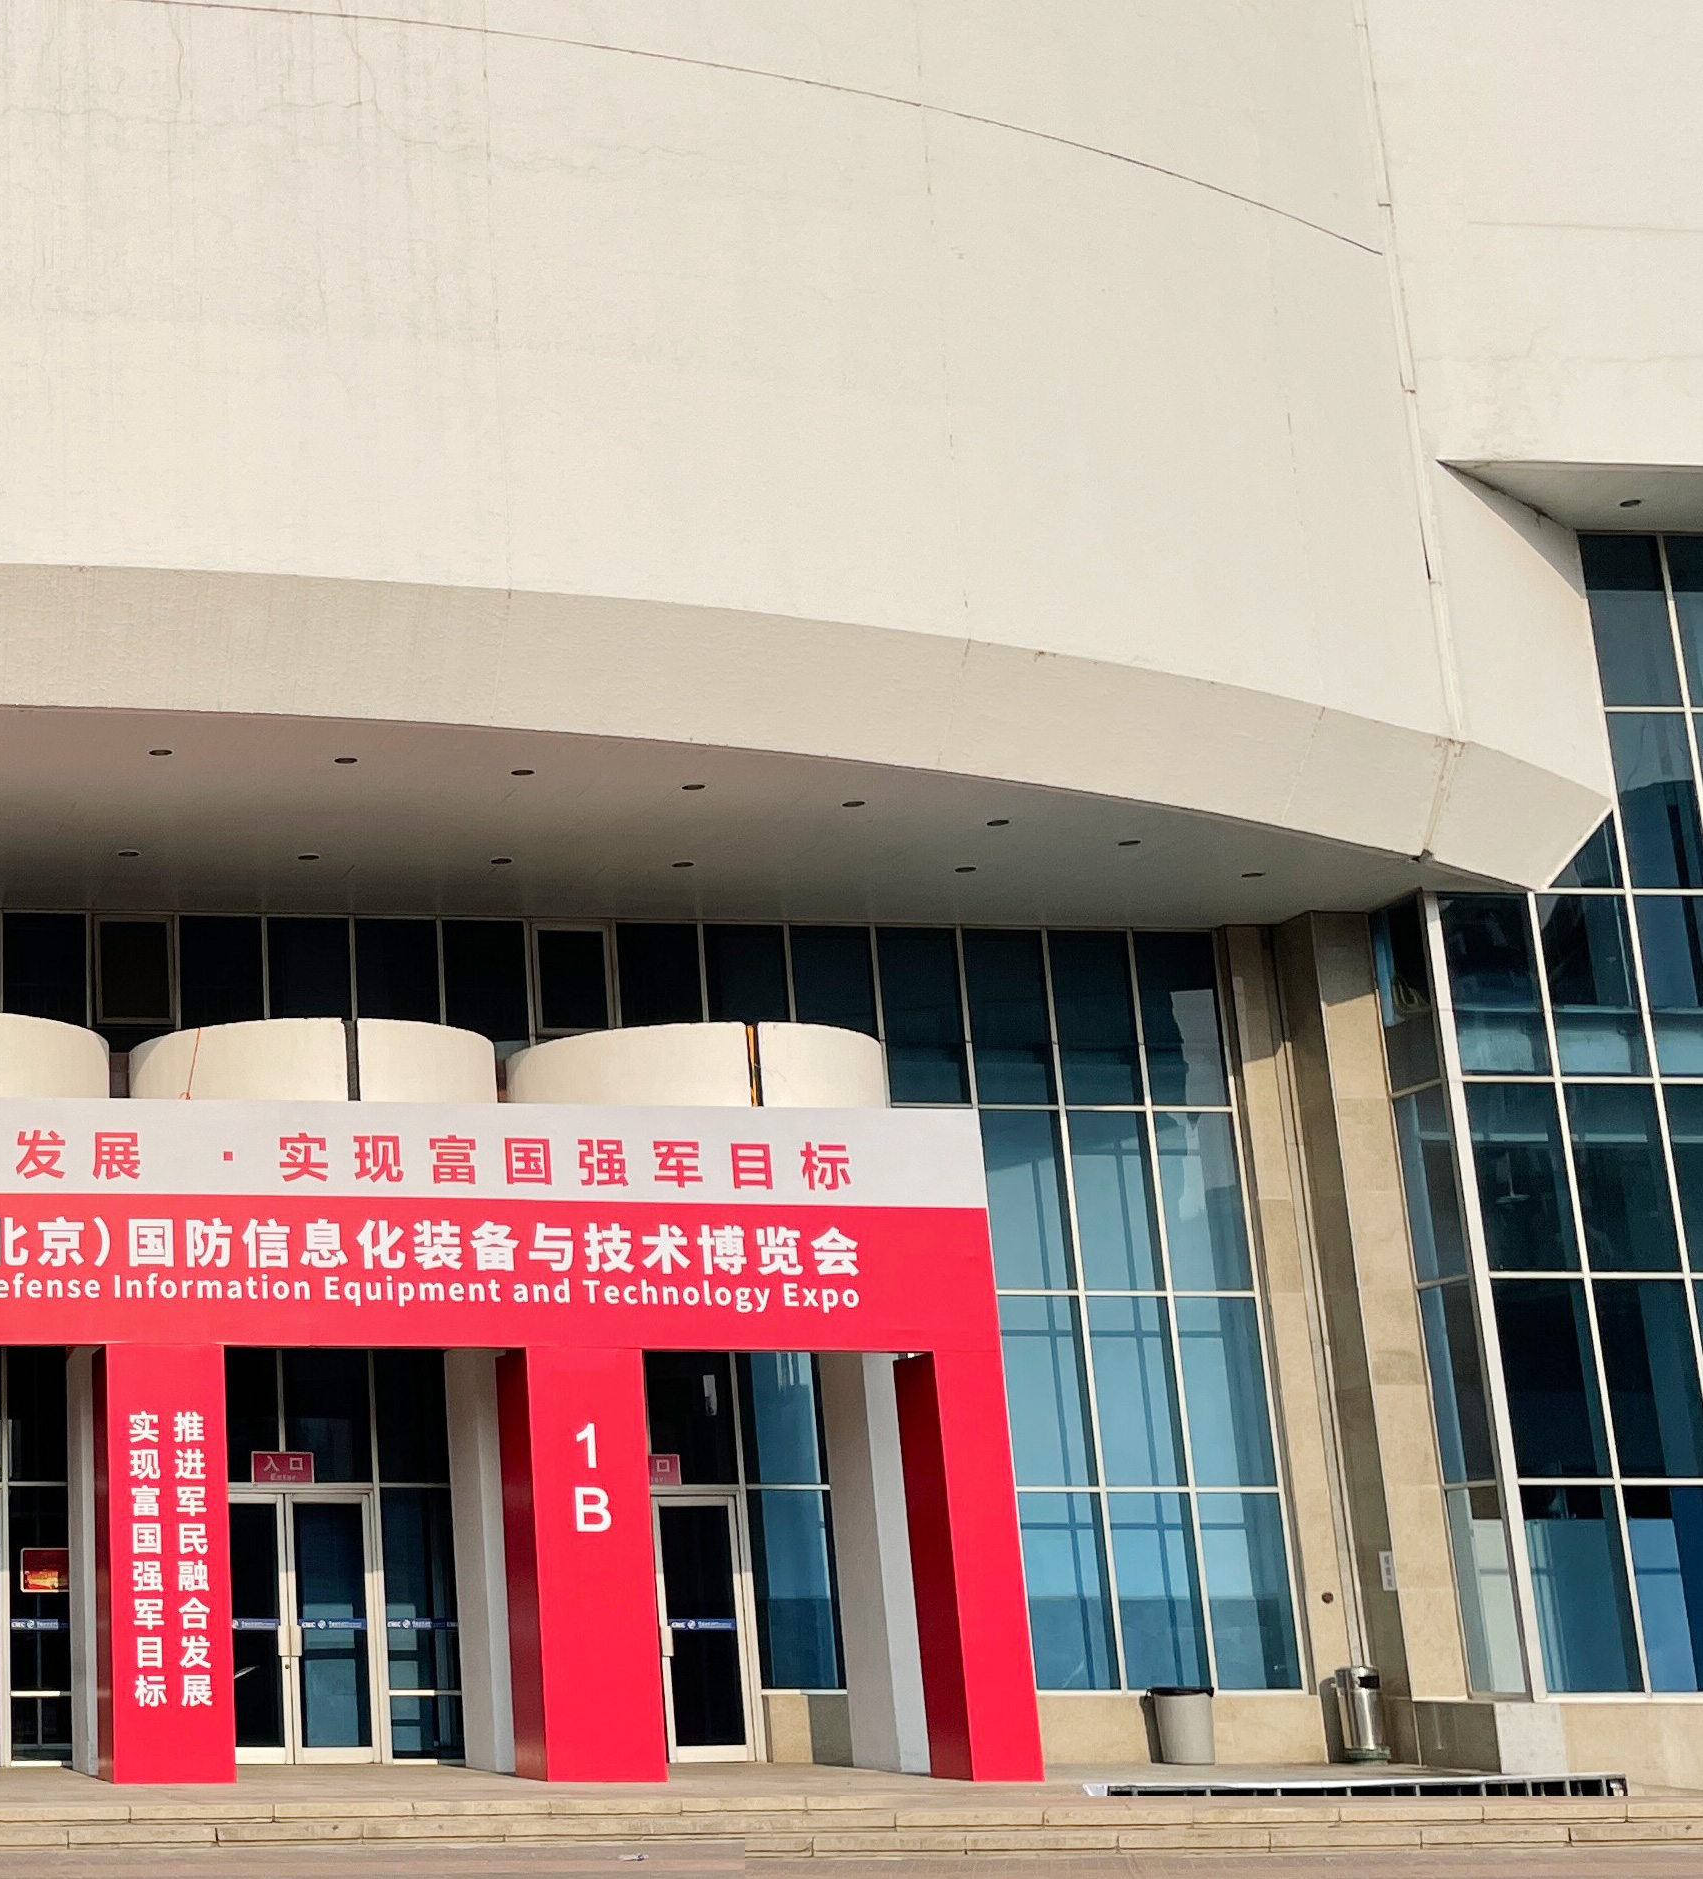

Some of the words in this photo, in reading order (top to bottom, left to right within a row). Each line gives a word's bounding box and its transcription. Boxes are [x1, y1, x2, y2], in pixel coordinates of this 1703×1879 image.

[279, 1132, 853, 1191] 实现富国强军目标
[115, 1273, 312, 1301] Information
[325, 1275, 502, 1308] Equipment
[514, 1278, 572, 1305] and
[583, 1279, 771, 1314] Technology
[784, 1283, 861, 1316] Expo
[263, 1455, 304, 1472] 入口
[576, 1423, 598, 1470] 1
[575, 1487, 613, 1534] B
[128, 1411, 168, 1708] 实现富国强军目标
[173, 1411, 214, 1708] 推进军民融合发展
